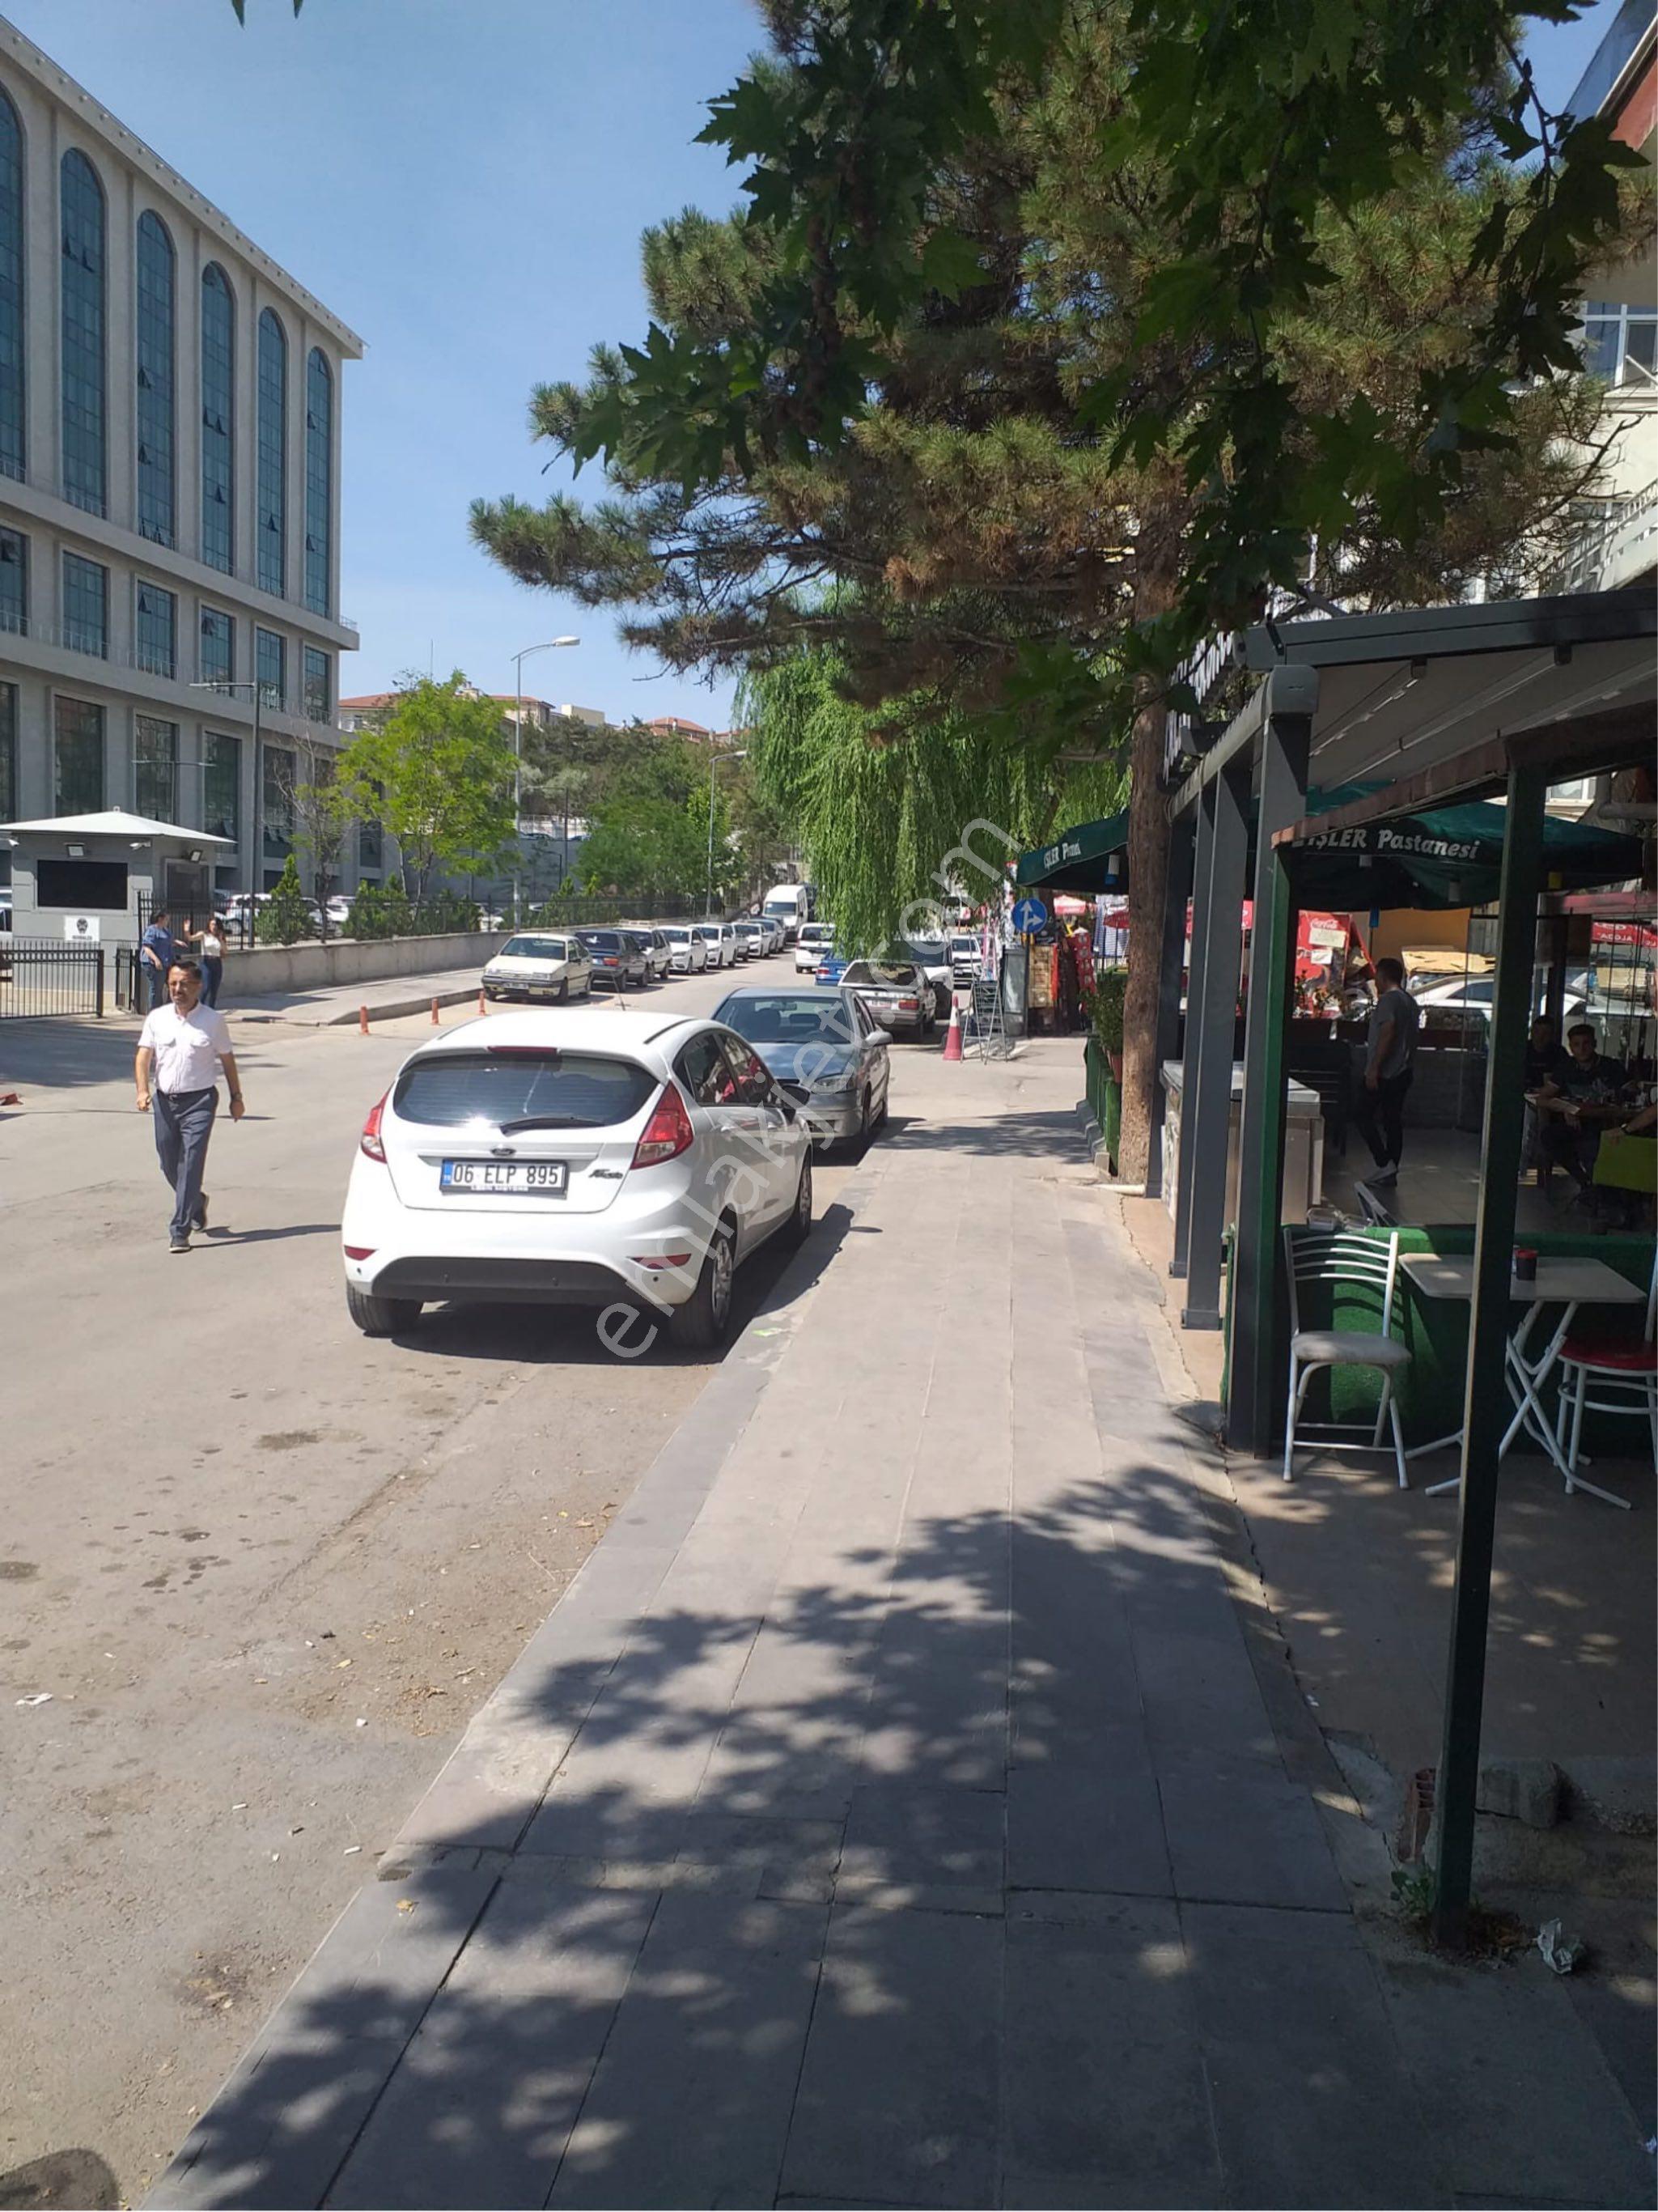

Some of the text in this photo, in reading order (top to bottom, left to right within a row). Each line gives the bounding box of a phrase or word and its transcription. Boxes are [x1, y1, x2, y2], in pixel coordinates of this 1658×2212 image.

[1377, 829, 1481, 859] Pastanesi
[453, 1163, 559, 1185] 06 ELP 895
